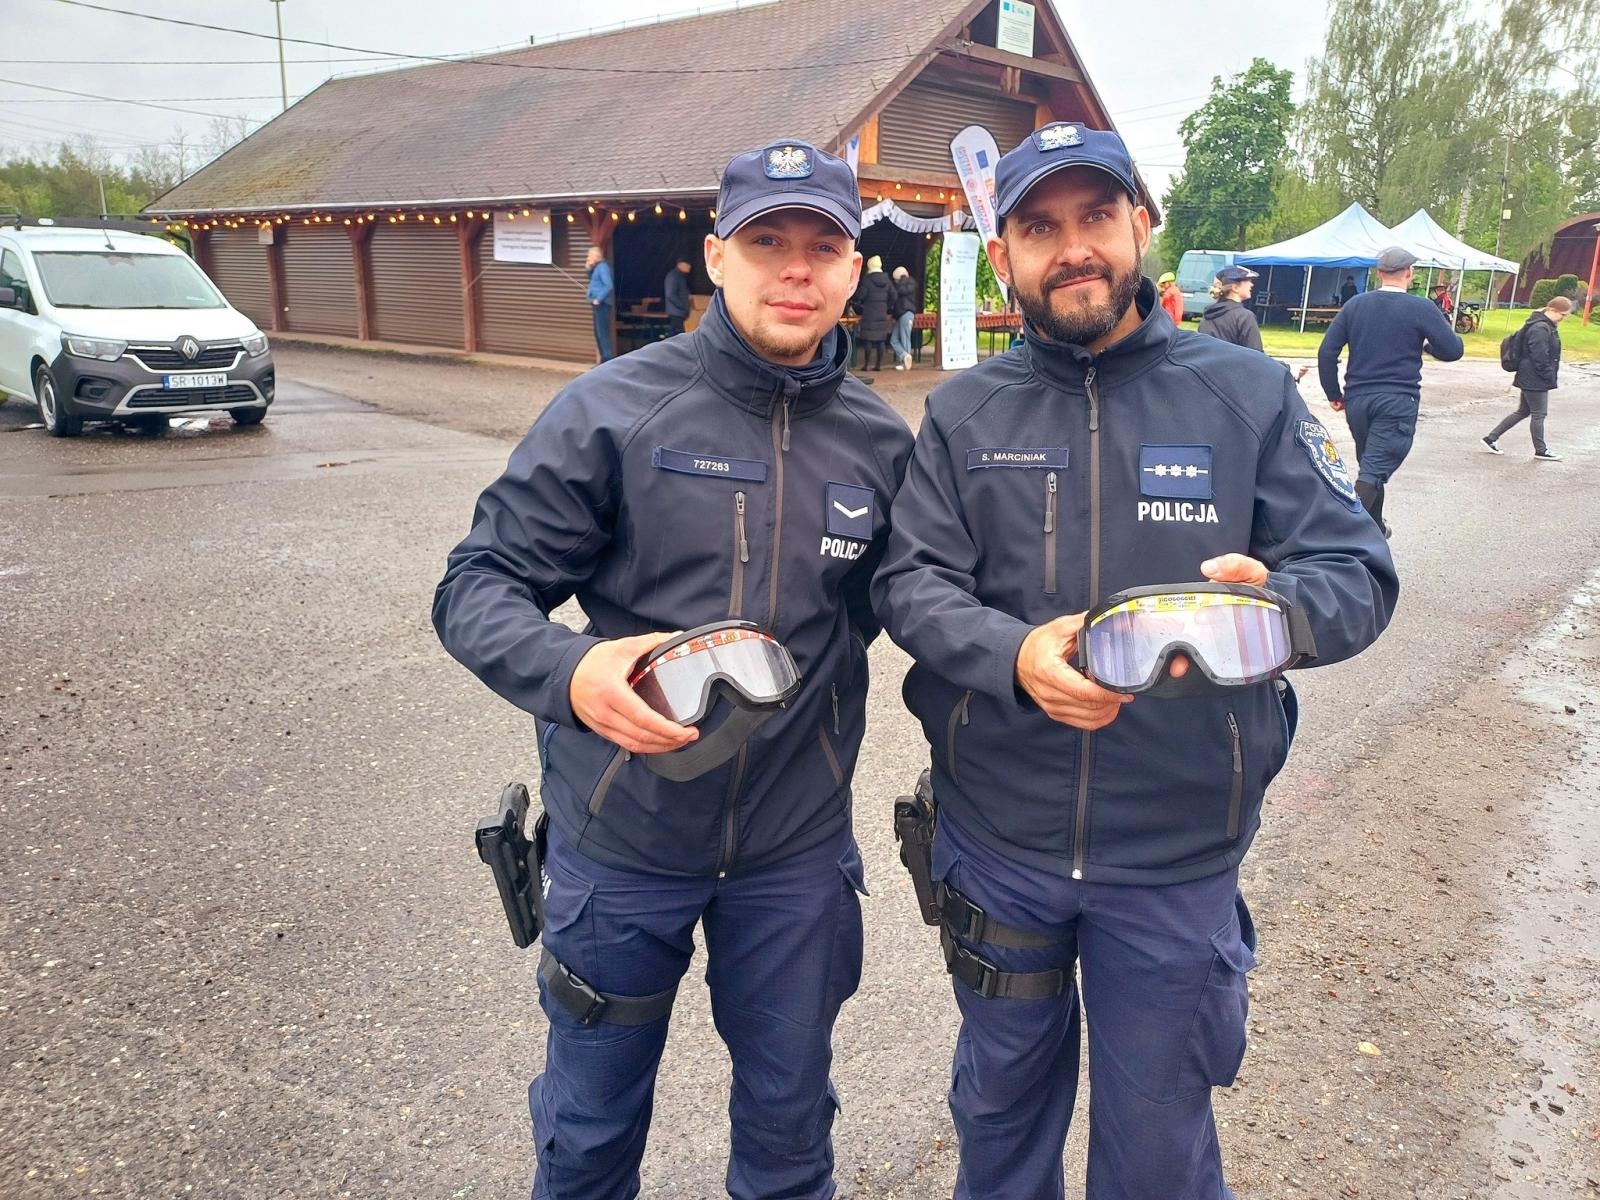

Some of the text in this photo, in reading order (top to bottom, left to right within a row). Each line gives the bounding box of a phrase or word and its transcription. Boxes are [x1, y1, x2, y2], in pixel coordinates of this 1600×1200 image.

[171, 376, 186, 388] SR
[981, 452, 1047, 462] S. MARCINIAK
[694, 459, 730, 473] 727263
[1137, 501, 1219, 523] POLICJA
[820, 536, 868, 560] POLICJ
